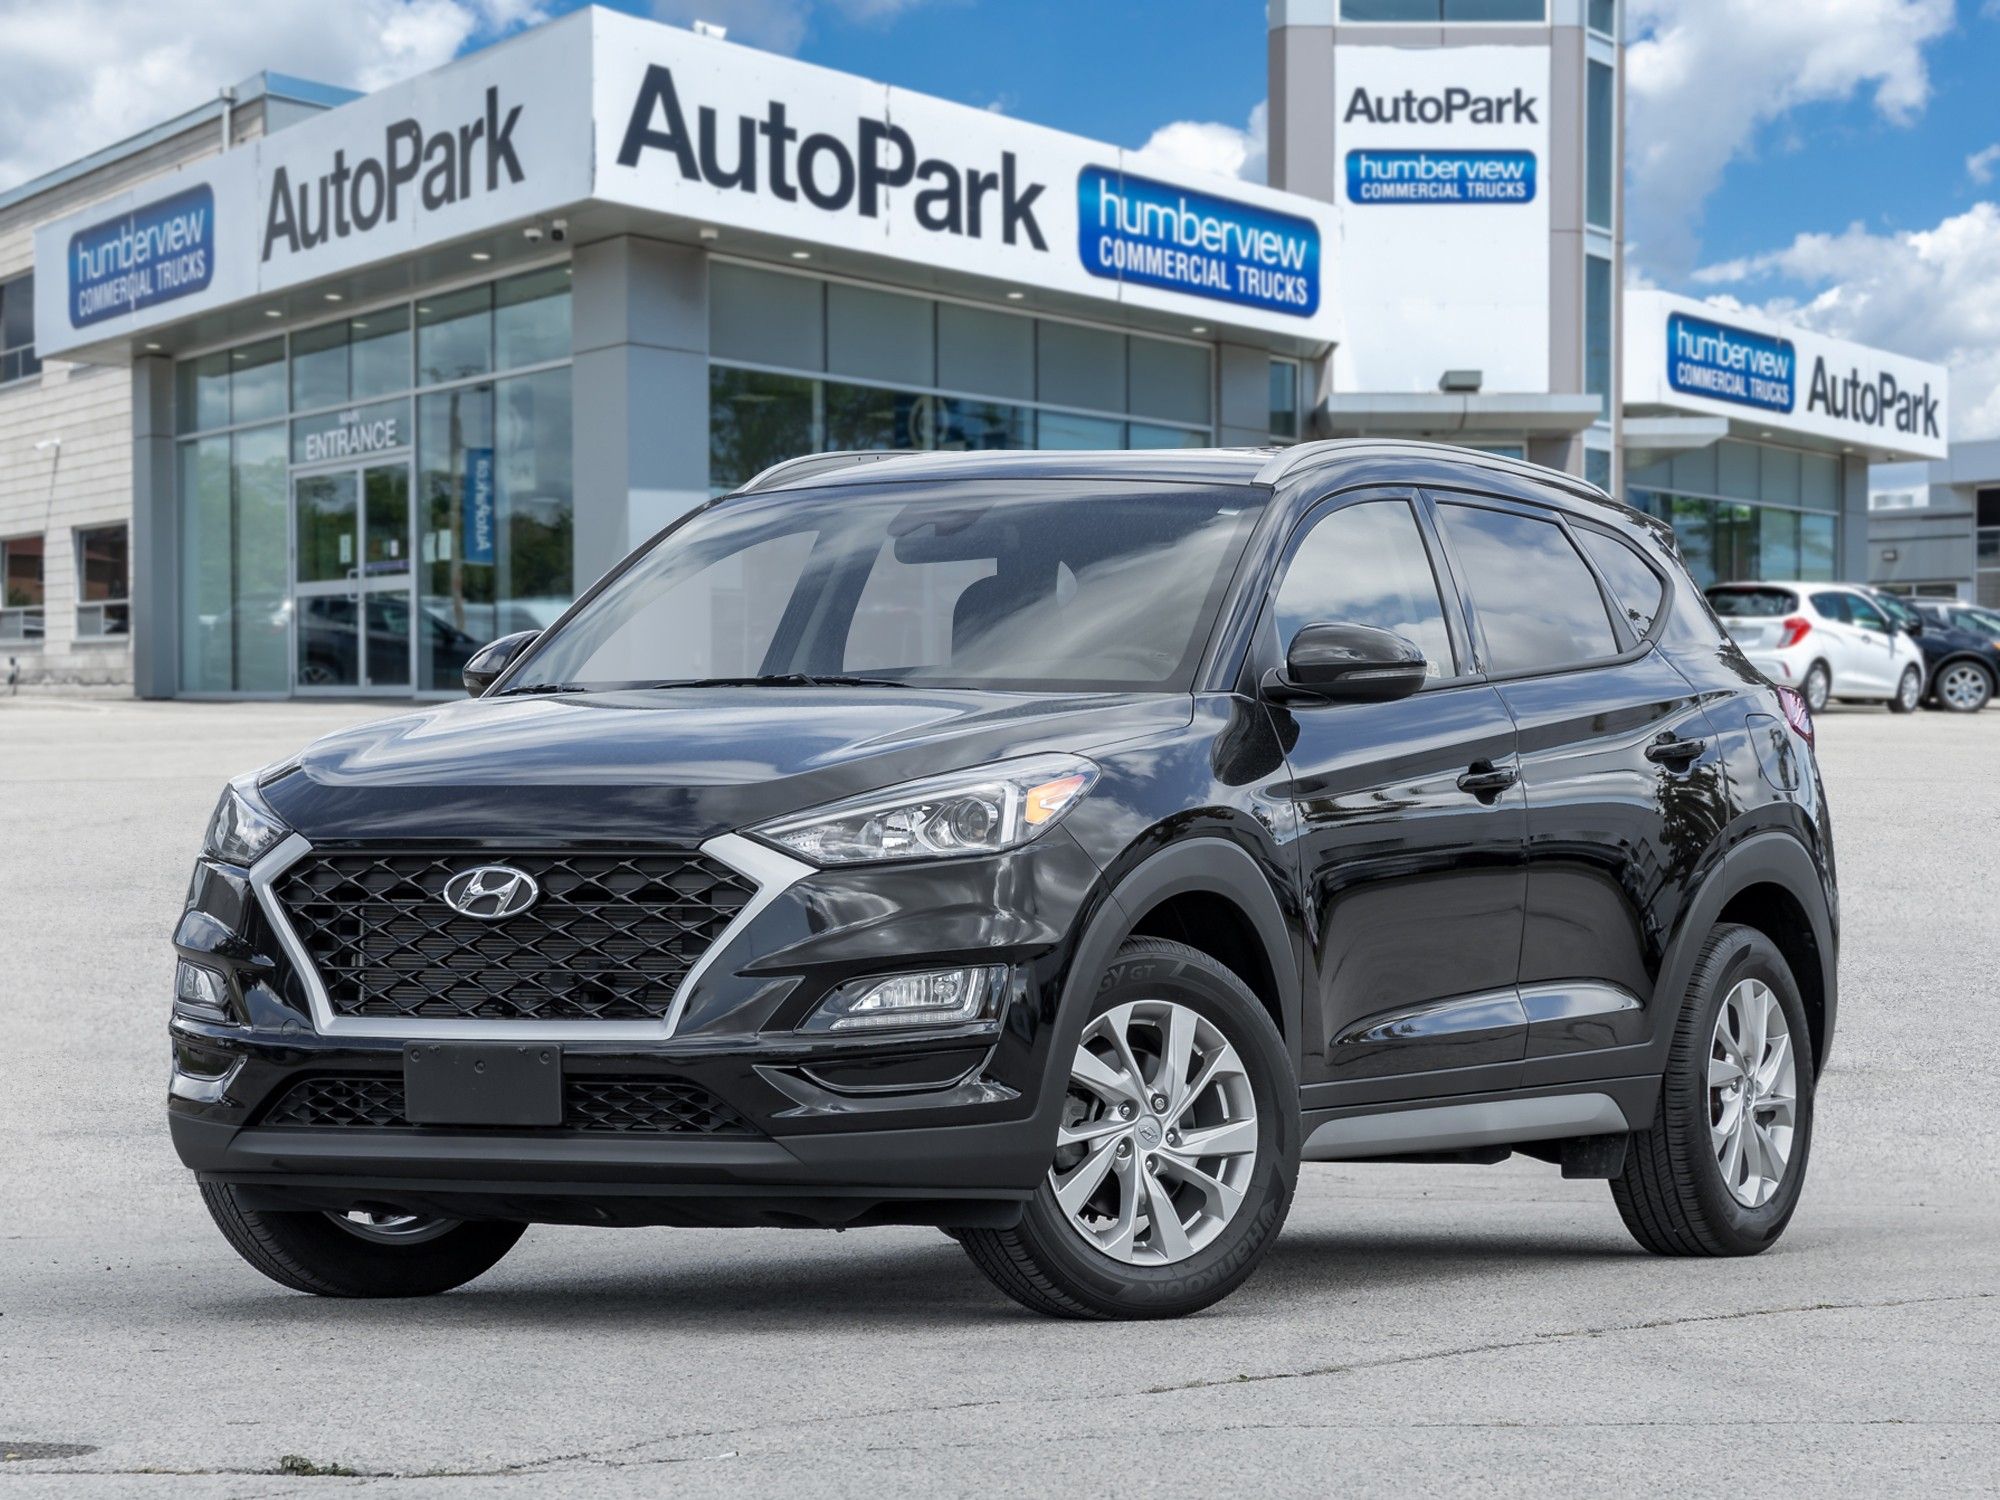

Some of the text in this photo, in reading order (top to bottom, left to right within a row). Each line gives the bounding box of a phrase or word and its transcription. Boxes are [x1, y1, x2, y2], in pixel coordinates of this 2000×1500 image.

[1343, 87, 1539, 124] AutoPark
[262, 85, 525, 262] AutoPark
[616, 62, 1049, 252] AutoPark
[1360, 154, 1525, 180] humberview
[1361, 182, 1526, 199] COMMERCIAL TRUCKS
[78, 209, 205, 283] humberview
[1099, 178, 1307, 270] humberview
[79, 249, 206, 317] COMMERCIAL TRUCKS
[1100, 236, 1308, 305] COMMERCIAL TRUCKS
[1677, 321, 1790, 379] humberview
[1677, 362, 1790, 405] COMMERCIAL TRUCKS
[1807, 355, 1940, 439] AutoPark
[305, 418, 397, 460] ENTRANCE
